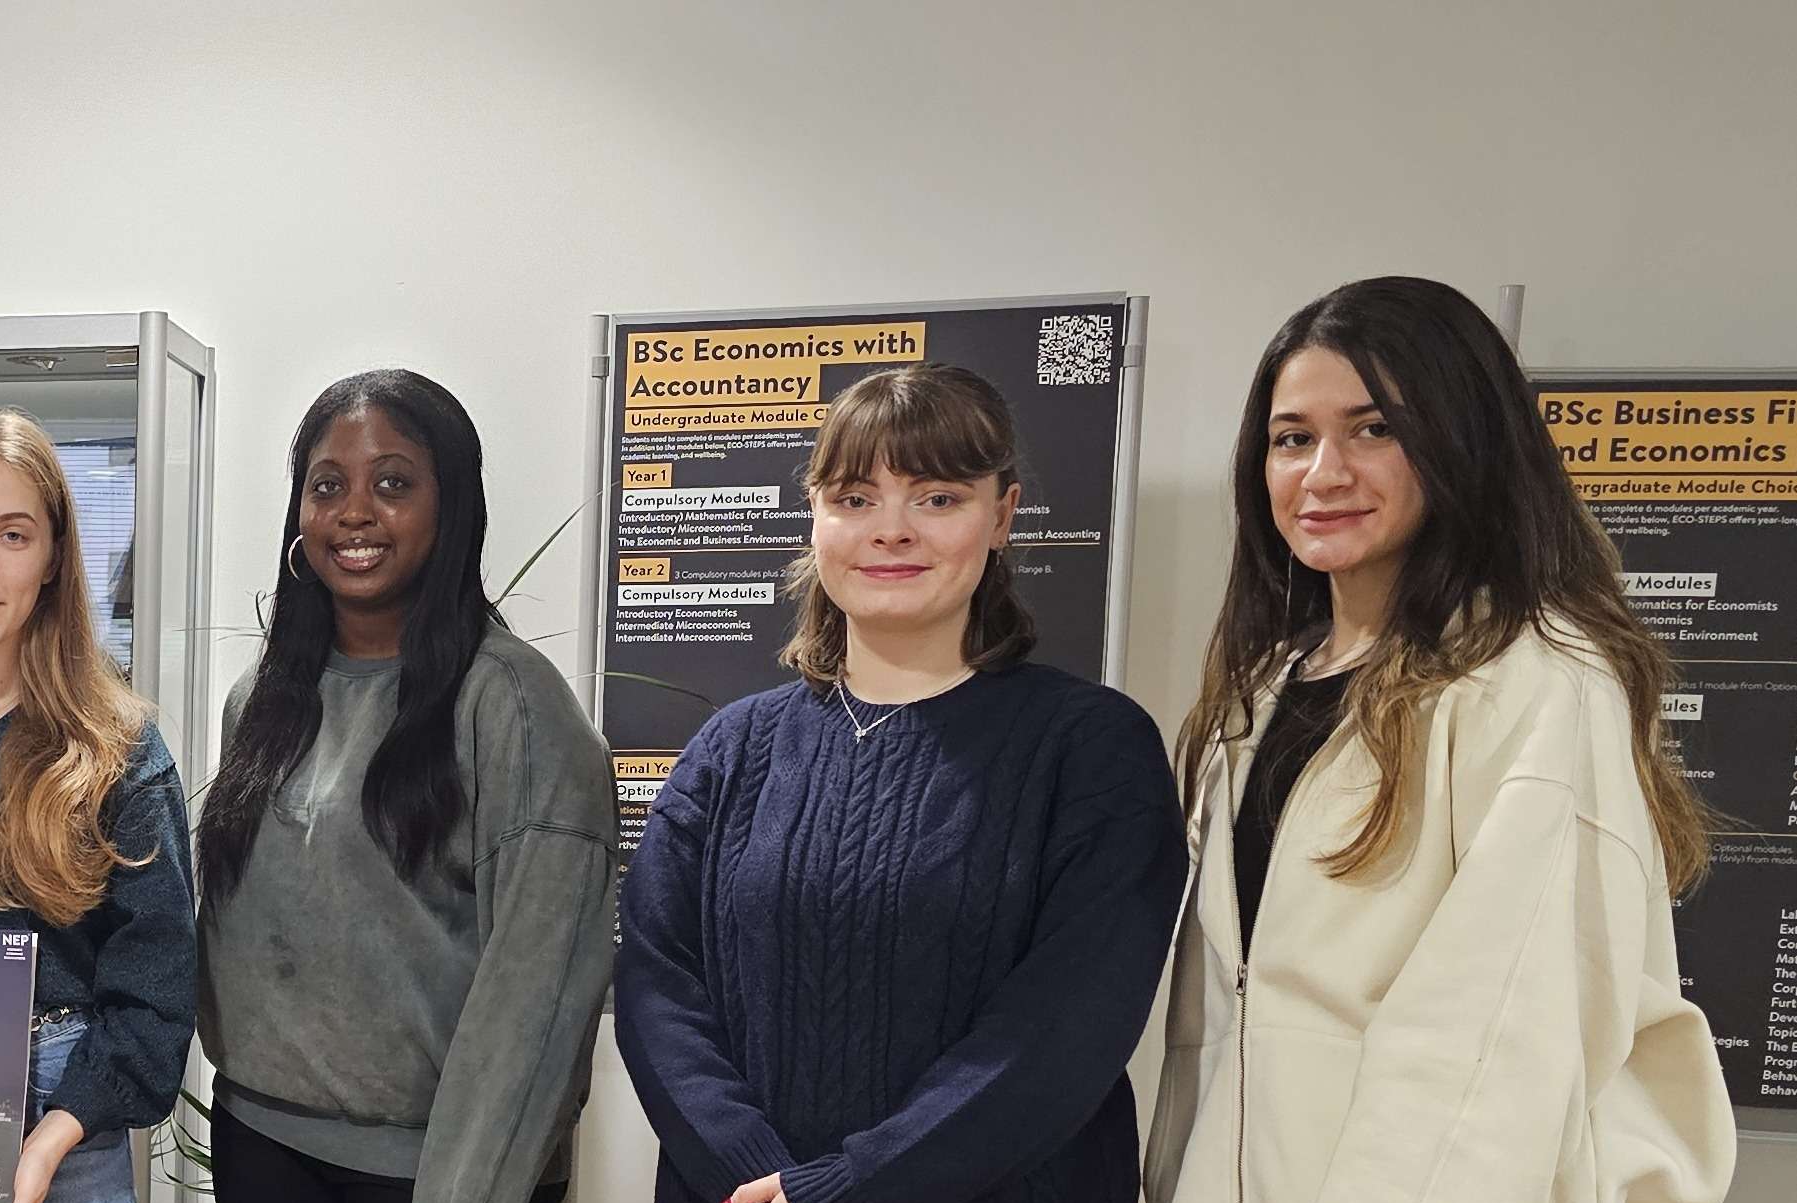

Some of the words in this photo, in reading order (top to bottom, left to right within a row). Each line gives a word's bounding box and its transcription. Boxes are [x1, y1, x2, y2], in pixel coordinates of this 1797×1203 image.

[634, 340, 684, 363] BSc
[694, 335, 844, 361] Economics
[854, 331, 916, 355] with
[631, 374, 812, 399] Accountancy
[631, 412, 745, 428] Undergraduate
[751, 409, 808, 422] Module
[1544, 400, 1602, 425] BSc
[1615, 400, 1755, 425] Business
[1559, 437, 1598, 462] nd
[1609, 437, 1787, 463] Economics
[628, 470, 657, 482] Year
[661, 470, 666, 481] 1
[1575, 480, 1672, 497] ergraduate
[1677, 480, 1746, 494] Module
[625, 495, 707, 509] Compulsory
[711, 493, 771, 504] Modules
[1013, 505, 1051, 515] nomists
[1602, 504, 1644, 514] complete
[1646, 504, 1652, 512] 6
[1654, 504, 1693, 512] modules
[1694, 506, 1711, 514] per
[1712, 504, 1756, 512] academic
[1757, 506, 1780, 514] year.
[619, 512, 683, 523] (Introductory)
[685, 511, 745, 521] Mathematics
[747, 510, 760, 520] for
[763, 510, 815, 519] Economists
[1641, 515, 1670, 524] below,
[1672, 515, 1727, 524] ECO-STEPS
[1729, 515, 1756, 524] offers
[619, 524, 676, 535] Introductory
[678, 523, 753, 534] Microeconomics
[1009, 531, 1043, 541] ement
[1044, 529, 1101, 541] Accounting
[1625, 527, 1670, 536] wellbeing.
[618, 537, 635, 547] The
[637, 536, 682, 546] Economic
[683, 535, 700, 545] and
[703, 535, 741, 544] Business
[743, 535, 803, 544] Environment
[624, 564, 652, 576] Year
[657, 564, 665, 575] 2
[681, 570, 728, 580] Compulsory
[729, 569, 762, 578] modules
[763, 569, 778, 579] plus
[1635, 576, 1712, 590] Modules
[622, 588, 704, 602] Compulsory
[708, 587, 767, 599] Modules
[1627, 599, 1682, 610] hematics
[1686, 599, 1704, 610] for
[1707, 600, 1778, 611] Economists
[617, 609, 673, 620] Introductory
[675, 609, 738, 618] Econometrics
[616, 621, 673, 631] Intermediate
[676, 620, 751, 630] Microeconomics
[616, 633, 673, 643] Intermediate
[675, 632, 753, 642] Macroeconomics
[1679, 630, 1758, 642] Environment
[1740, 681, 1762, 690] from
[1663, 699, 1698, 712] ules
[617, 762, 649, 773] Final
[654, 762, 670, 773] Ye
[2, 933, 29, 946] NEP
[1771, 997, 1797, 1008] Furt
[1712, 1036, 1749, 1048] tegies
[1766, 1041, 1788, 1052] The
